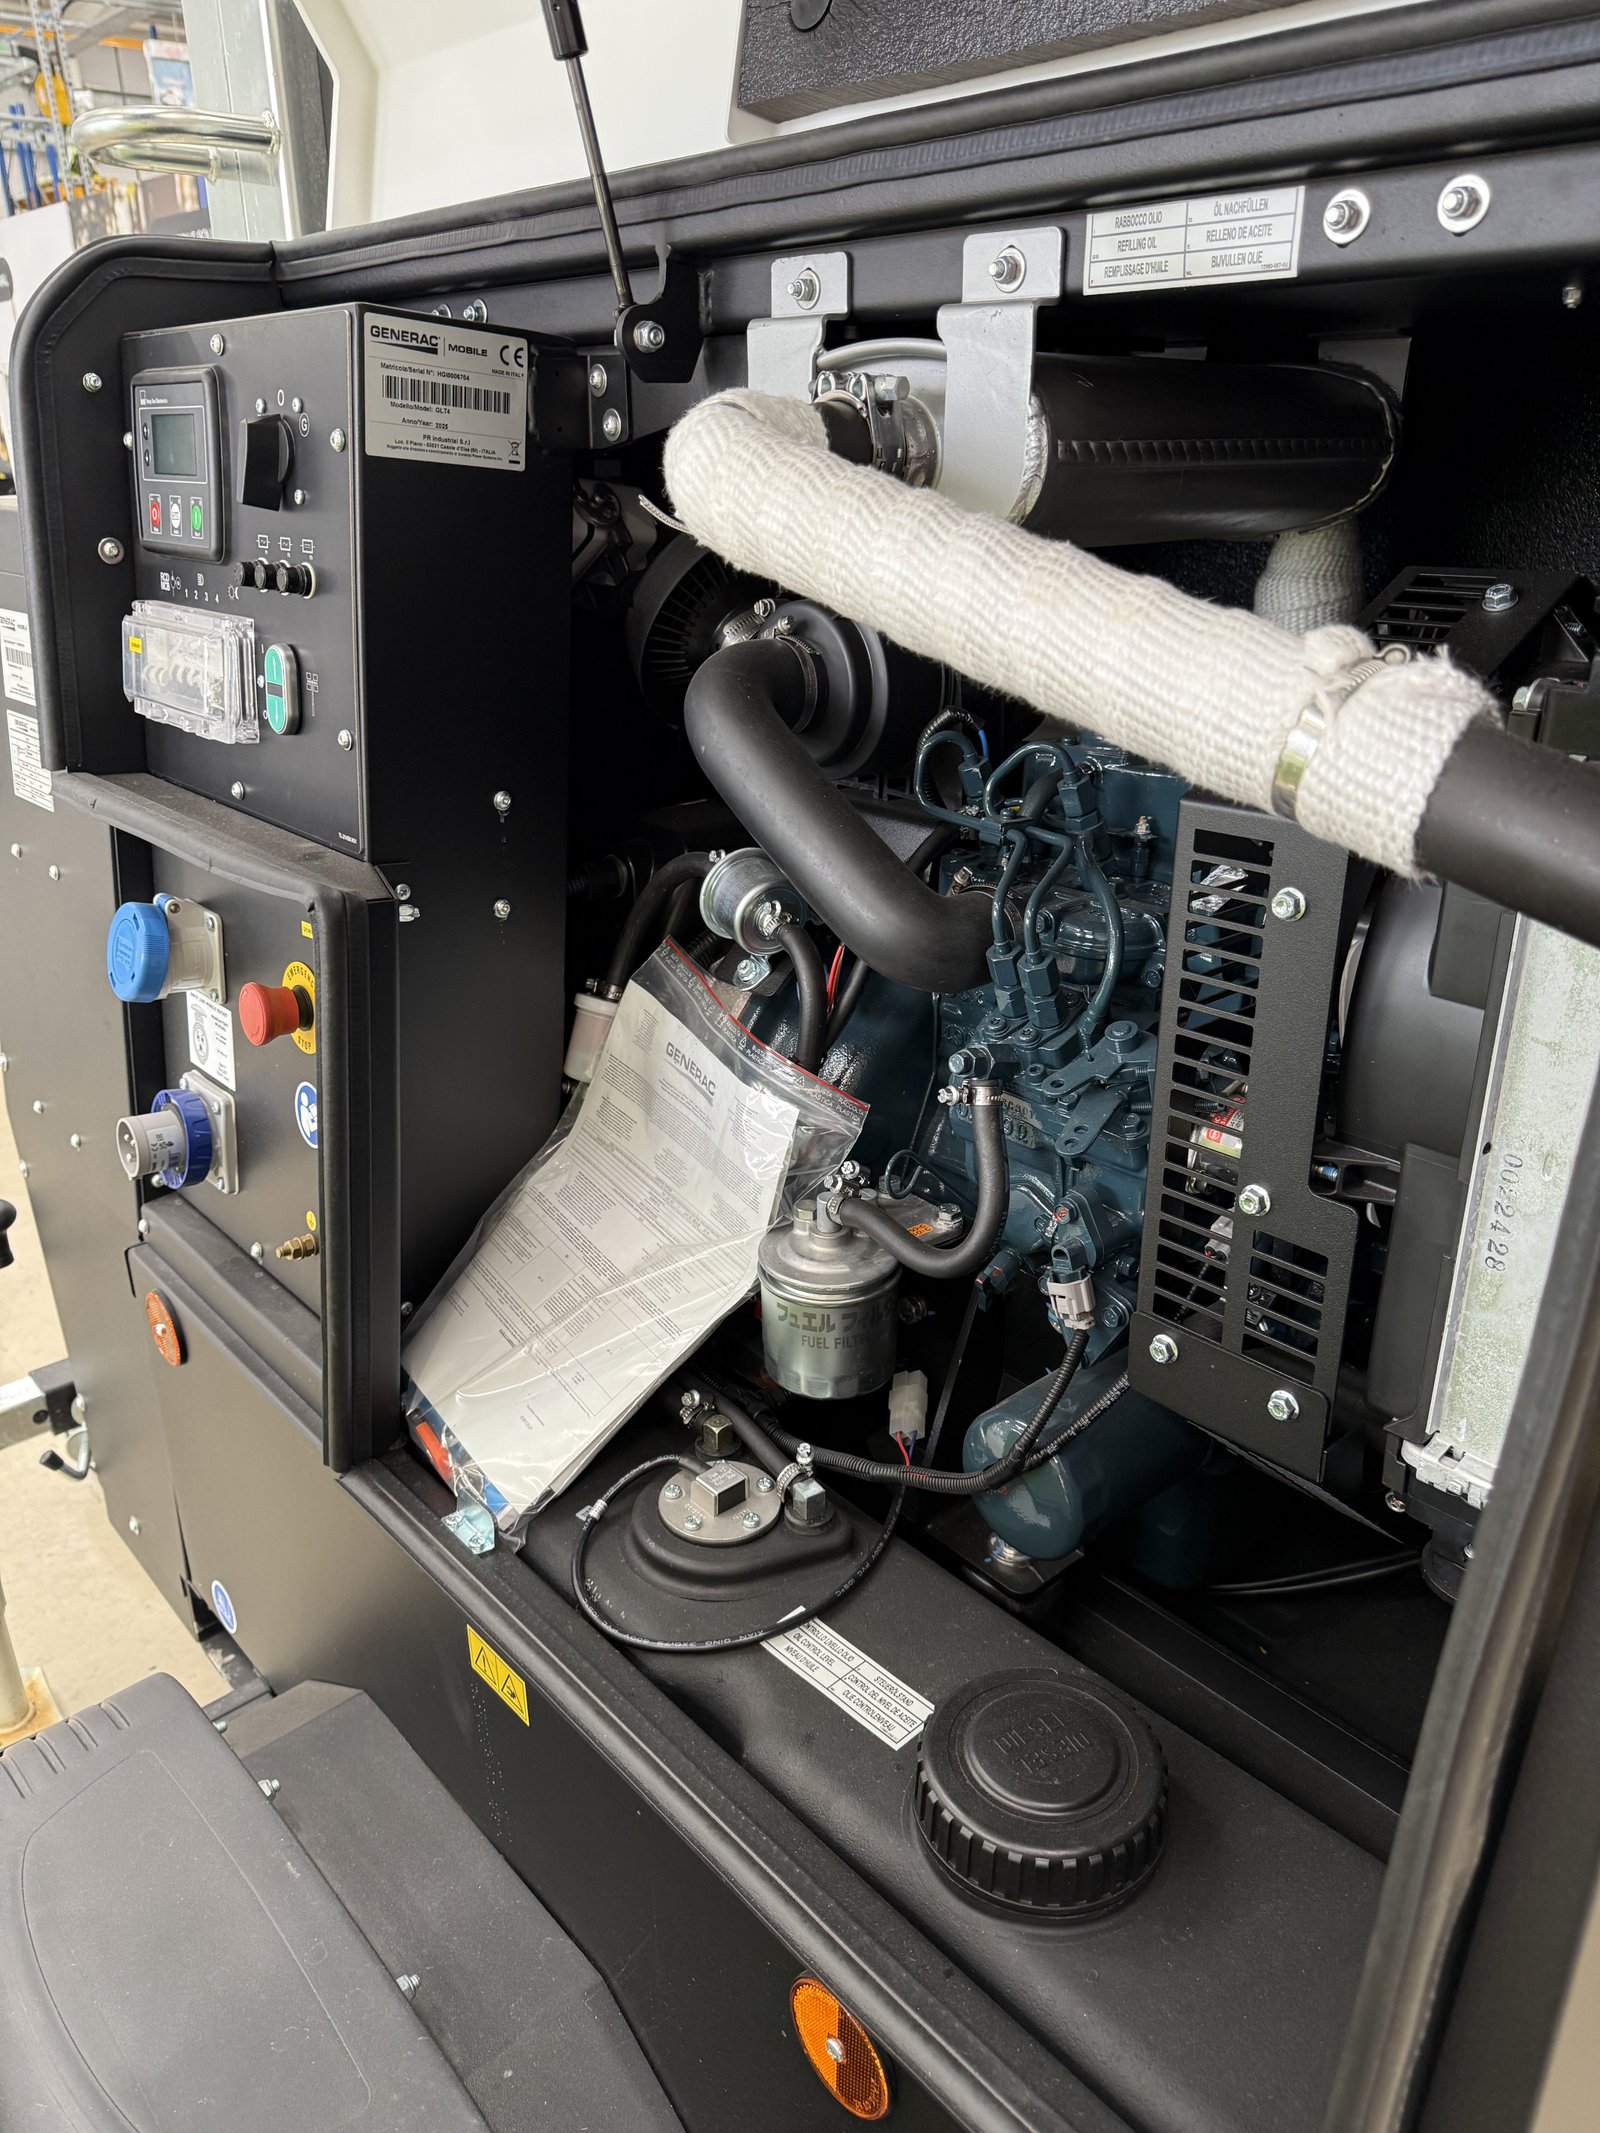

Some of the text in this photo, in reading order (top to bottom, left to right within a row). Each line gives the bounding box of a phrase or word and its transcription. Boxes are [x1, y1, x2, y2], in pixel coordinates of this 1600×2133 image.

[1214, 197, 1269, 216] ÖL NACHFÜLLEN
[1114, 211, 1162, 229] RABBOCCO OLIO
[1206, 224, 1272, 242] RELLENO DE ACEITE
[1117, 237, 1157, 252] REFILLING OIL
[1211, 250, 1263, 268] BIJVULLEN OLIE
[1104, 260, 1168, 279] REMPLISSAGE D'HUILE
[370, 325, 488, 357] GENERAC MOBILE
[380, 362, 425, 375] Matricola/Serial
[492, 368, 505, 376] MADE
[390, 401, 450, 415] Modello/Model: GLT4
[402, 418, 448, 430] Anno/Year: 2025
[432, 435, 458, 444] Industrial
[185, 588, 220, 604] 1 2 3 4
[287, 966, 314, 988] EMERGENC
[298, 1036, 312, 1050] STOP
[666, 1042, 716, 1097] GENERAC
[814, 1084, 864, 1116] BUSTA RACCOLTA
[776, 1302, 836, 1333] フュエル
[802, 1335, 830, 1349] FUEL
[856, 1562, 870, 1576] PVC
[704, 1638, 732, 1647] QING
[738, 1630, 764, 1640] XIAN
[802, 1622, 854, 1662] ONTROLLO LIVELLO OLIO
[793, 1632, 836, 1666] OIL CONTROL LEVEL
[784, 1644, 820, 1673] NIVEAU D'HUILE
[874, 1676, 914, 1707] STEUERÖLSTAND
[842, 1688, 896, 1732] OLIE CONTROLENIVEAU
[848, 1674, 917, 1728] CONTROL DEL NIVEL DE ACEITE
